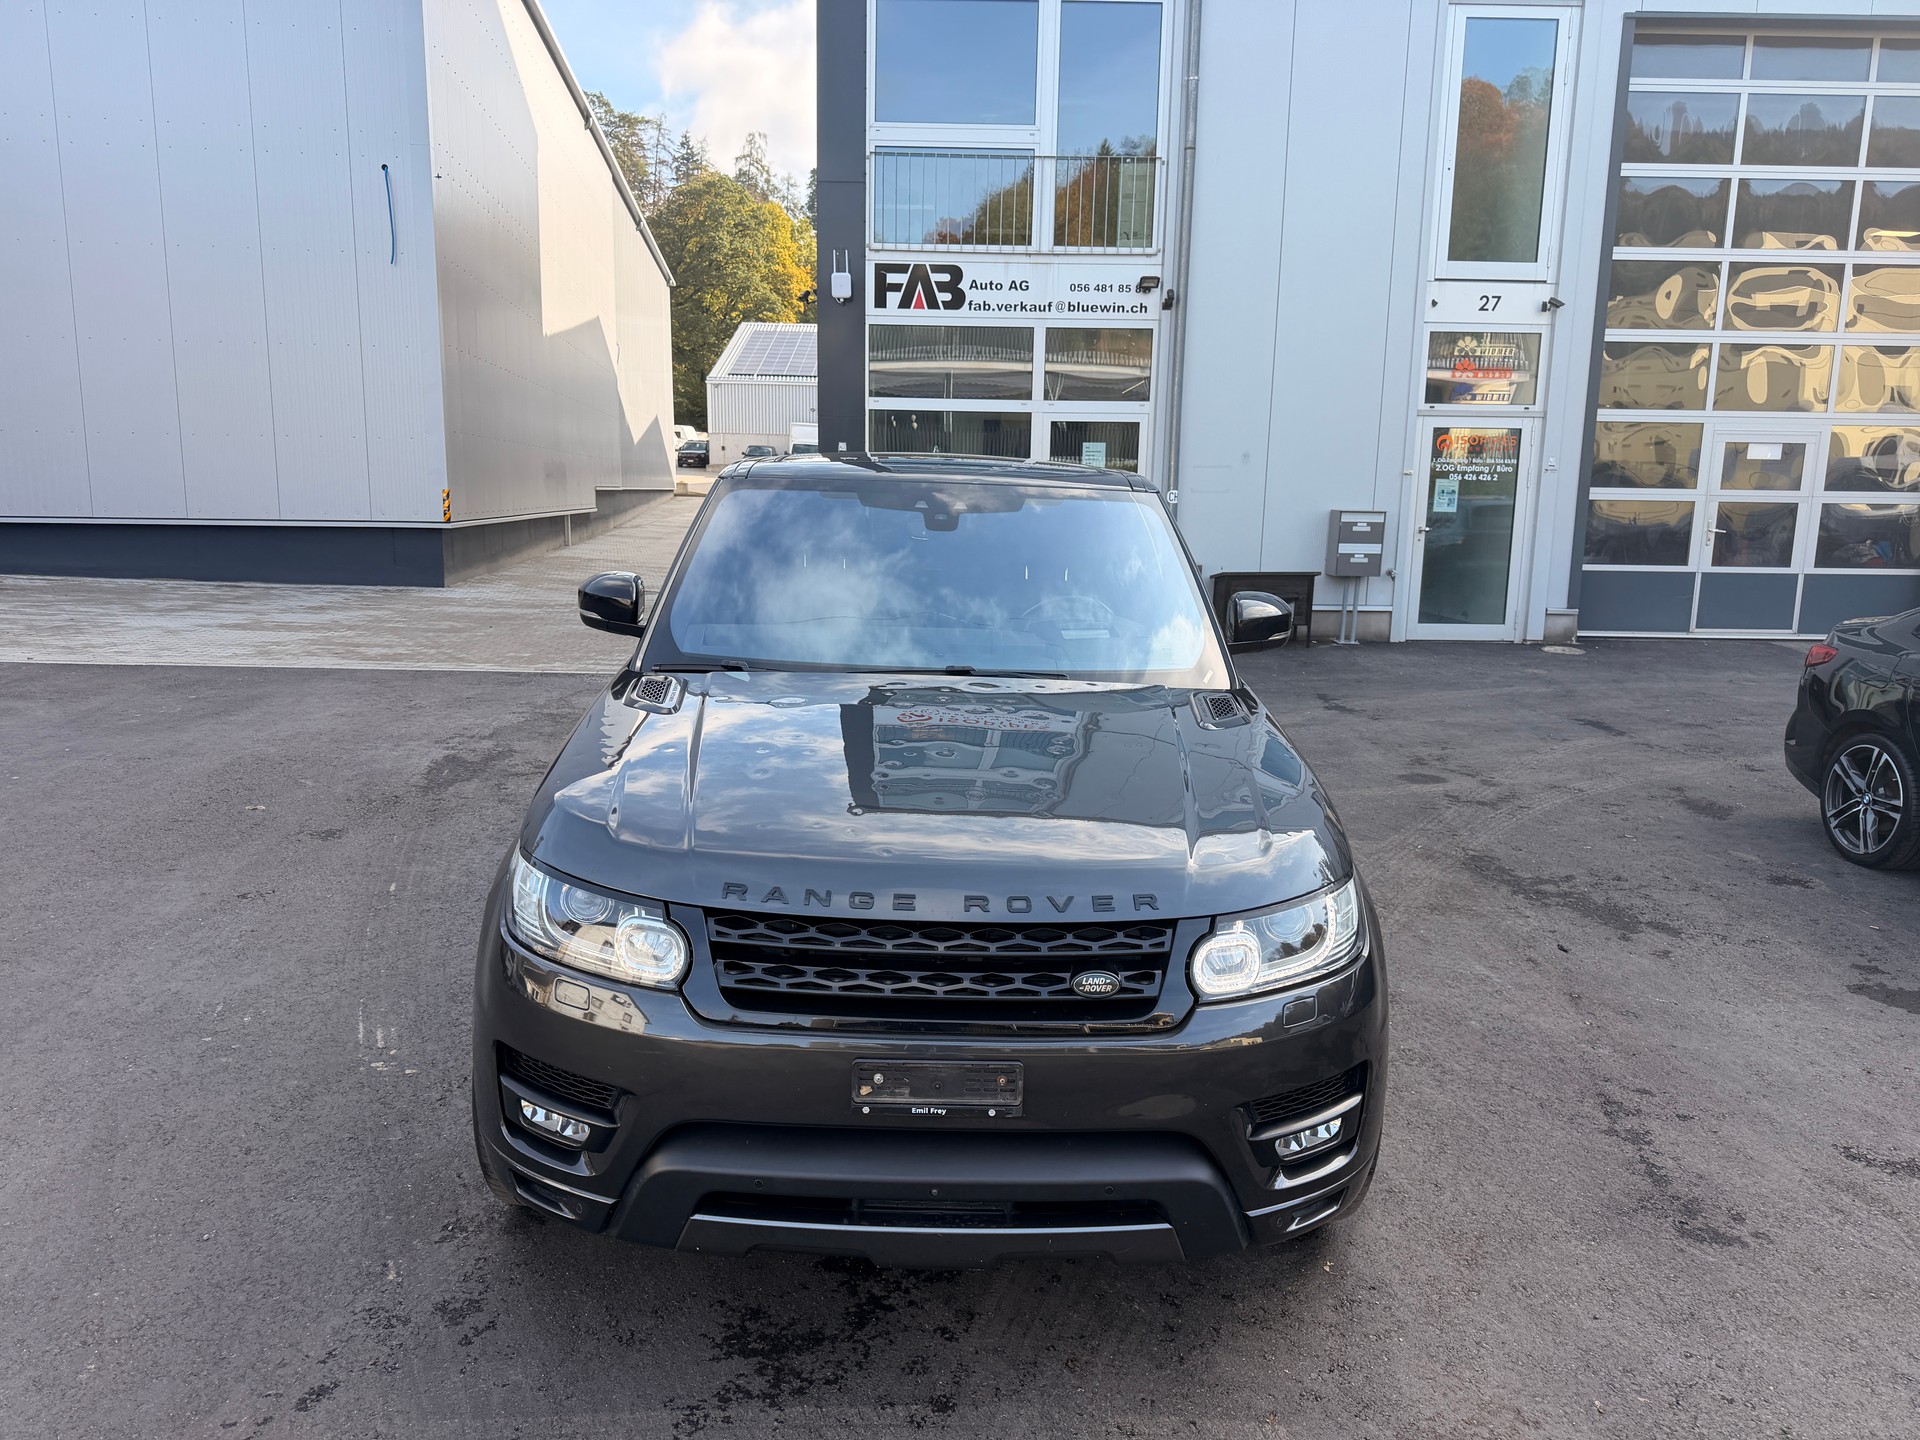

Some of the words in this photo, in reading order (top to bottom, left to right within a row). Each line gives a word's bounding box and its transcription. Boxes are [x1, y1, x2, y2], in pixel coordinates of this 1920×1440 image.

[874, 263, 966, 310] FAB
[968, 279, 1003, 292] Auto
[1008, 280, 1030, 292] AG
[1069, 283, 1091, 293] 056
[1093, 284, 1114, 293] 481
[1117, 284, 1132, 293] 85
[967, 300, 1148, 314] fab.verkauf@bluewin.ch
[1478, 295, 1502, 312] 27
[1456, 464, 1489, 473] Empfang
[721, 881, 917, 912] RANGE
[963, 893, 1160, 913] ROVER
[1082, 977, 1106, 985] LAND
[1083, 984, 1113, 992] ROVER
[930, 1107, 947, 1116] Frey
